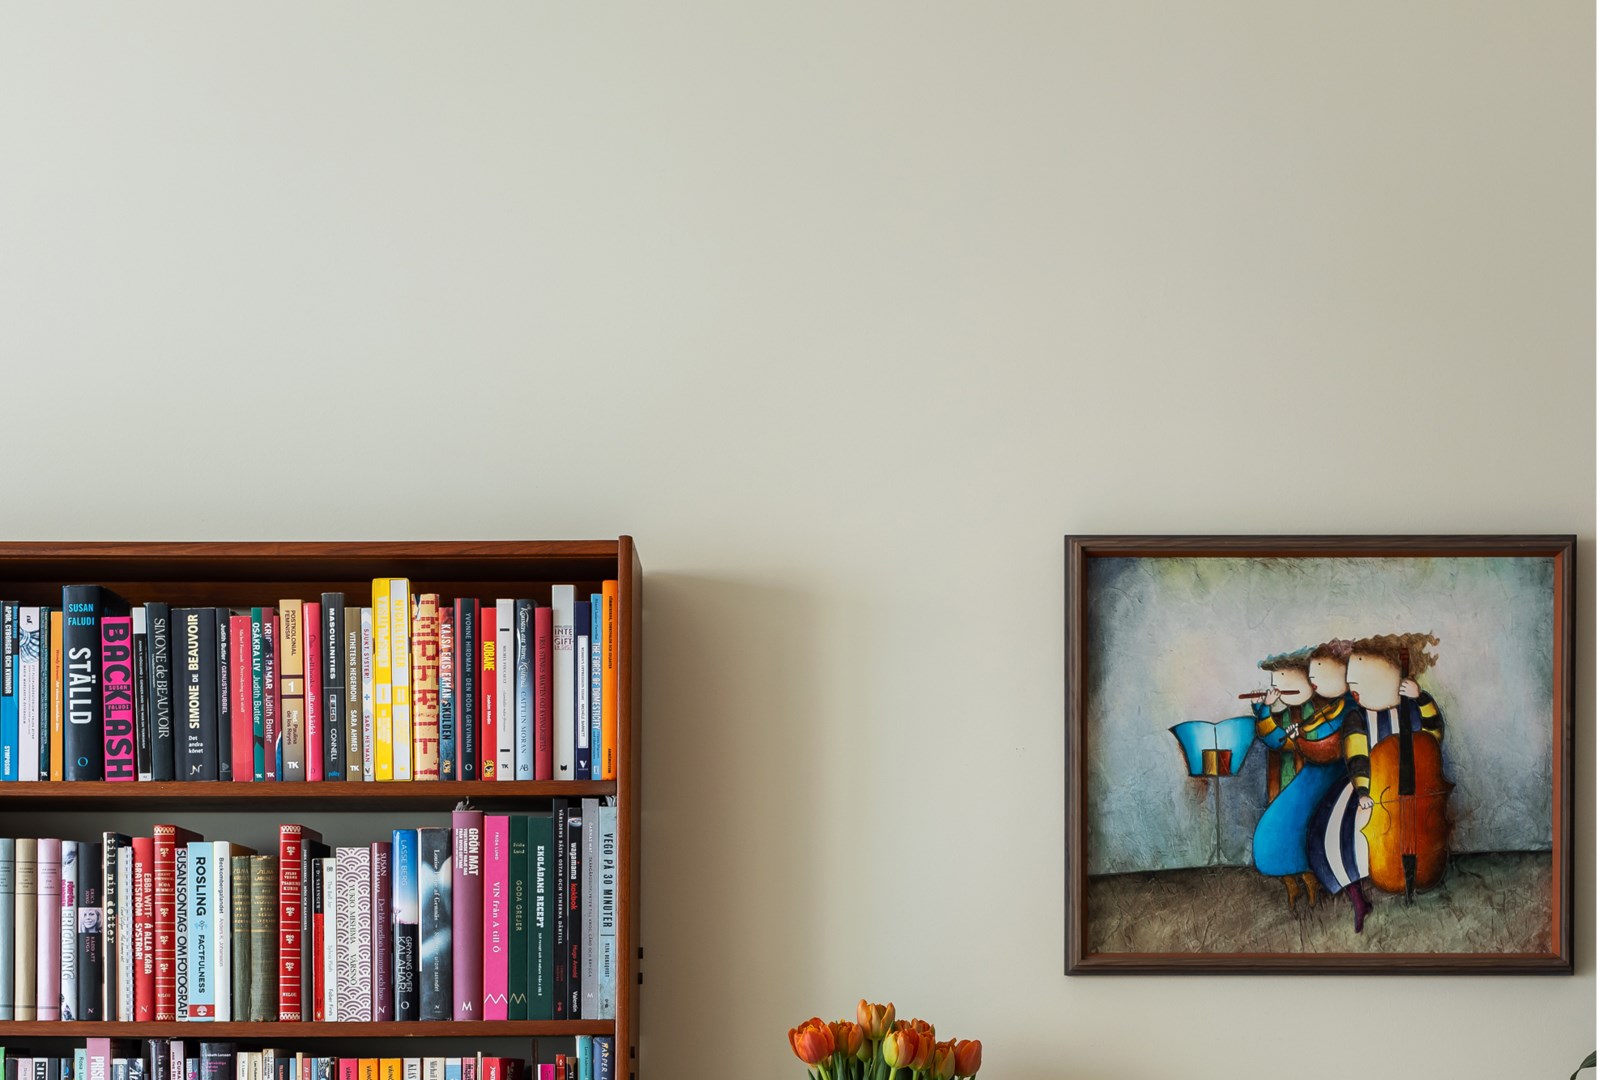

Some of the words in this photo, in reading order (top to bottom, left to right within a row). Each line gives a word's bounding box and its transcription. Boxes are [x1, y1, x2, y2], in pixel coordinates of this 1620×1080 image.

[68, 603, 94, 613] SUSAN
[68, 617, 95, 626] FALUDI
[154, 618, 166, 662] SIMONE
[187, 615, 199, 670] BEAUVOIR
[252, 622, 261, 657] OSÄKRA
[441, 624, 451, 649] KAJSA
[4, 656, 12, 667] OCH
[442, 652, 451, 669] EKIS
[483, 641, 494, 671] KOBANE
[4, 669, 12, 694] KVINNOR
[156, 665, 167, 678] de
[192, 674, 198, 683] DE
[253, 675, 261, 694] Judith
[68, 647, 96, 725] STÄLLD
[442, 672, 451, 698] EKMAN
[103, 623, 132, 778] BACKLASH
[157, 681, 169, 738] BEAUVOIR
[189, 685, 200, 729] SIMONE
[253, 696, 261, 724] Butler
[442, 703, 451, 740] SKULDEN
[350, 728, 358, 752] AHMED
[107, 838, 116, 866] till
[468, 828, 479, 853] GRÖN
[603, 833, 612, 855] VEGO
[177, 850, 186, 887] SUSAN
[468, 856, 479, 875] MAT
[536, 845, 545, 893] EKOLÅDANS
[570, 843, 578, 879] wagamama
[603, 860, 614, 870] PÅ
[107, 874, 116, 895] min
[135, 863, 143, 916] BRATTSTRÖM
[144, 873, 152, 893] EBBA
[196, 857, 206, 916] ROSLING
[603, 874, 612, 885] 30
[66, 881, 74, 907] FÖRFÖRA
[570, 883, 578, 910] kokbok
[177, 888, 187, 932] SONTAG
[492, 900, 500, 918] från
[536, 896, 544, 928] RECEPT
[603, 890, 612, 927] MINUTER
[107, 901, 116, 943] dotter
[144, 932, 152, 951] ALLA
[177, 936, 187, 957] OM
[492, 930, 500, 942] till
[144, 953, 153, 974] KÄRA
[397, 936, 406, 993] KALAHARI
[177, 958, 187, 1018] FOTOGRAFI
